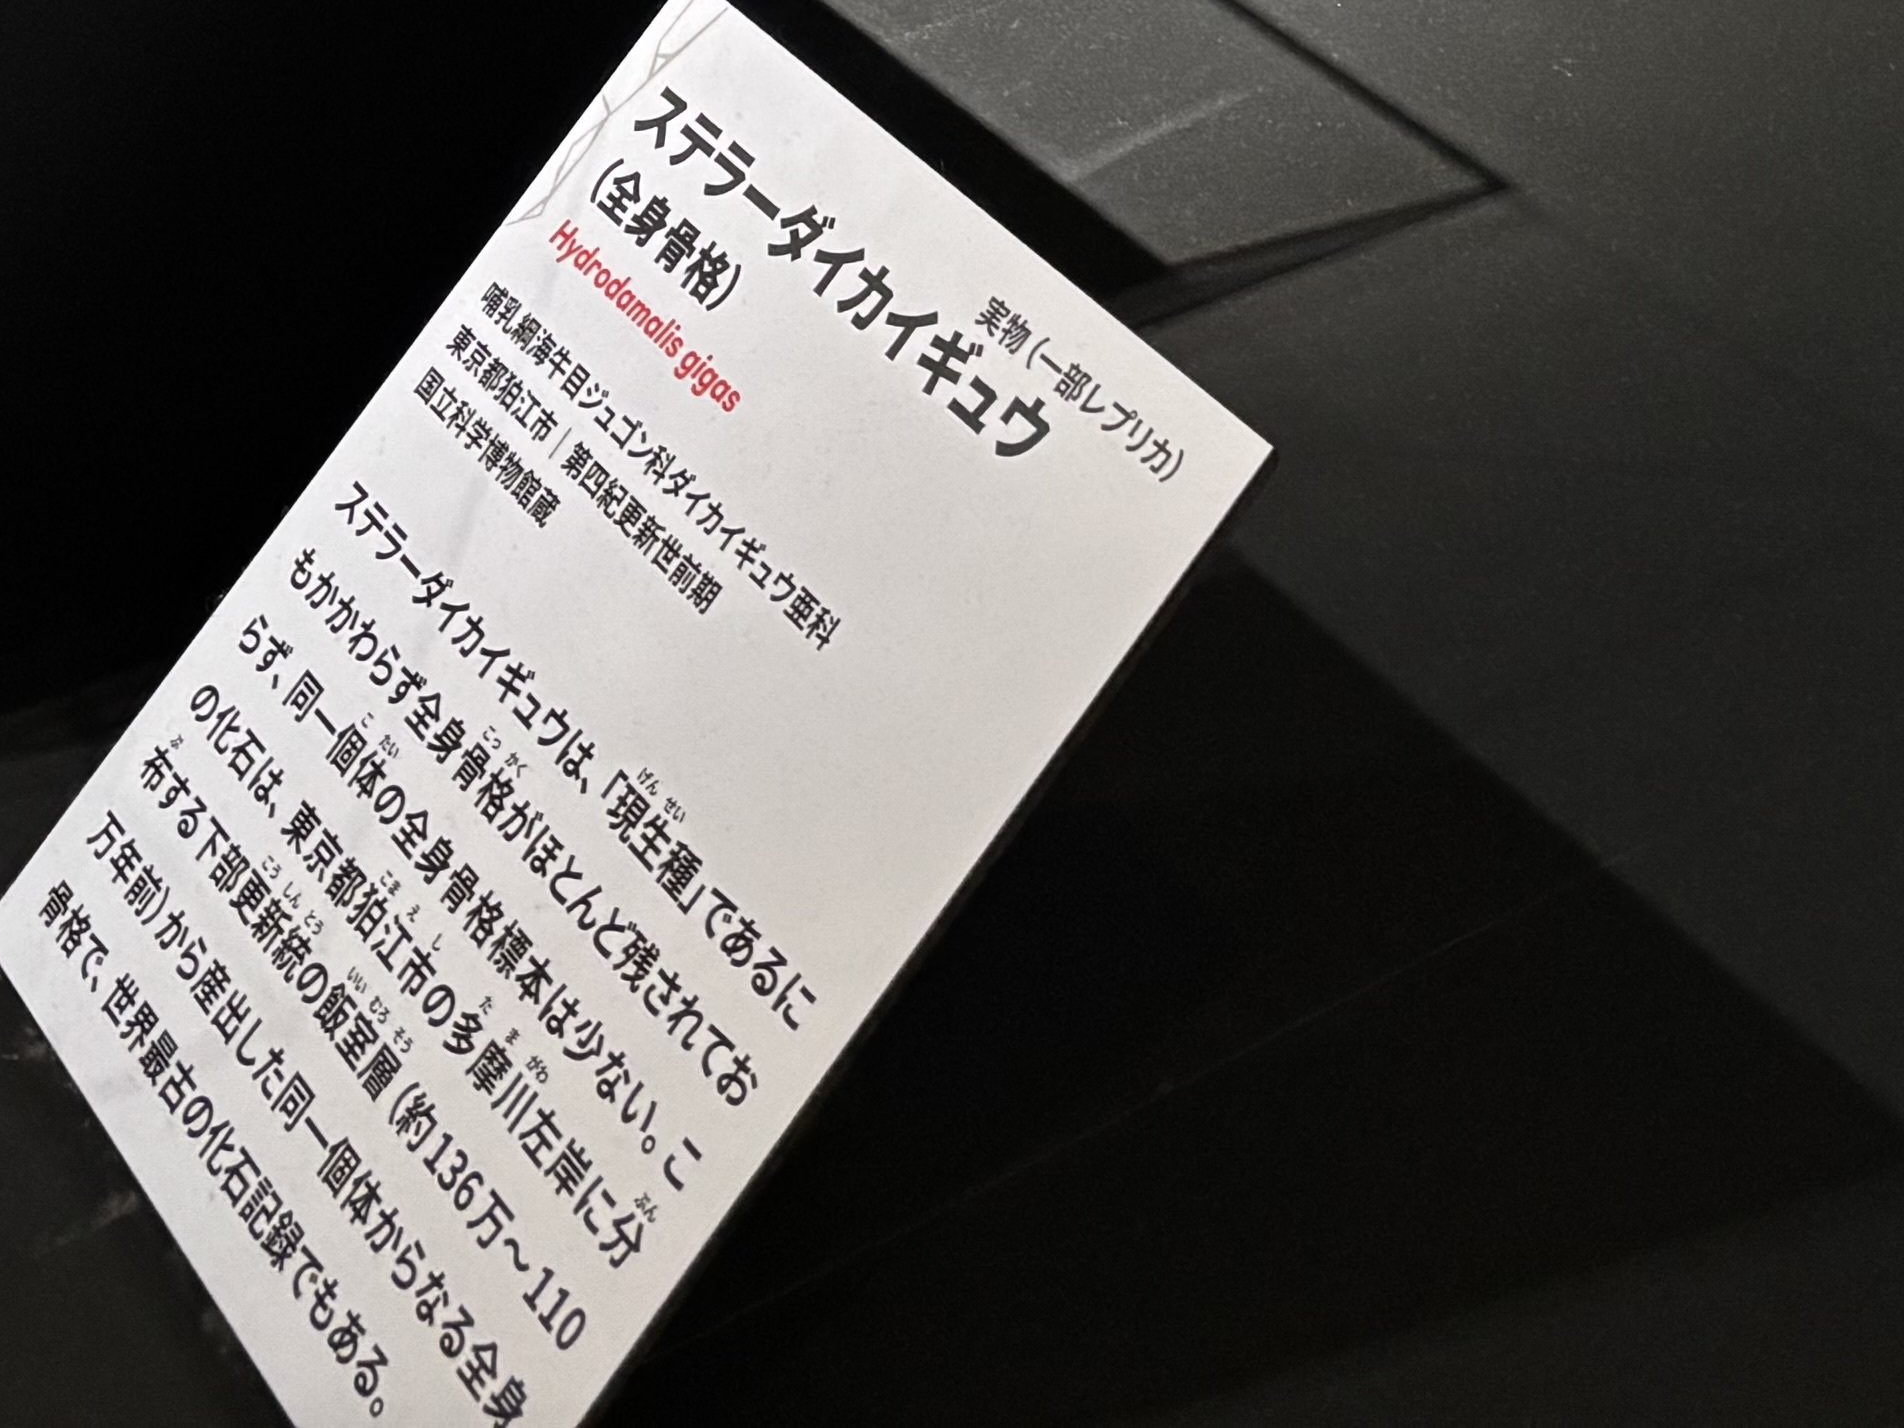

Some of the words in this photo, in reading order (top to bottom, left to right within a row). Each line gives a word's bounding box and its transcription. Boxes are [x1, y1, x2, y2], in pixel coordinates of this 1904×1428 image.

[413, 366, 561, 529] 国立科学博物館蔵
[549, 219, 684, 358] Hydrodamalis
[673, 350, 741, 412] gigas
[590, 158, 742, 312] （全身骨格）
[634, 86, 1051, 458] ステラーダイカイギュウ
[974, 296, 1184, 483] 実物（一部レプリカ）
[480, 281, 841, 651] 哺乳綱海牛目ジュゴン科ダイカイギュウ亜科
[190, 684, 644, 1269] の化石は、東京都狛江市の多摩川左岸に分
[238, 614, 703, 1191] らず、同一個体の全身骨格標本は少ない。こ
[290, 548, 758, 1107] もかかわらず全身骨格がほとんど残されてお
[334, 480, 817, 1031] ステラーダイカイギュウは、「現生種」であるに
[38, 879, 387, 1417] 骨格で、世界最古の化石記録でもある。
[86, 809, 527, 1428] 万年前）から産出した同一個体からなる全身
